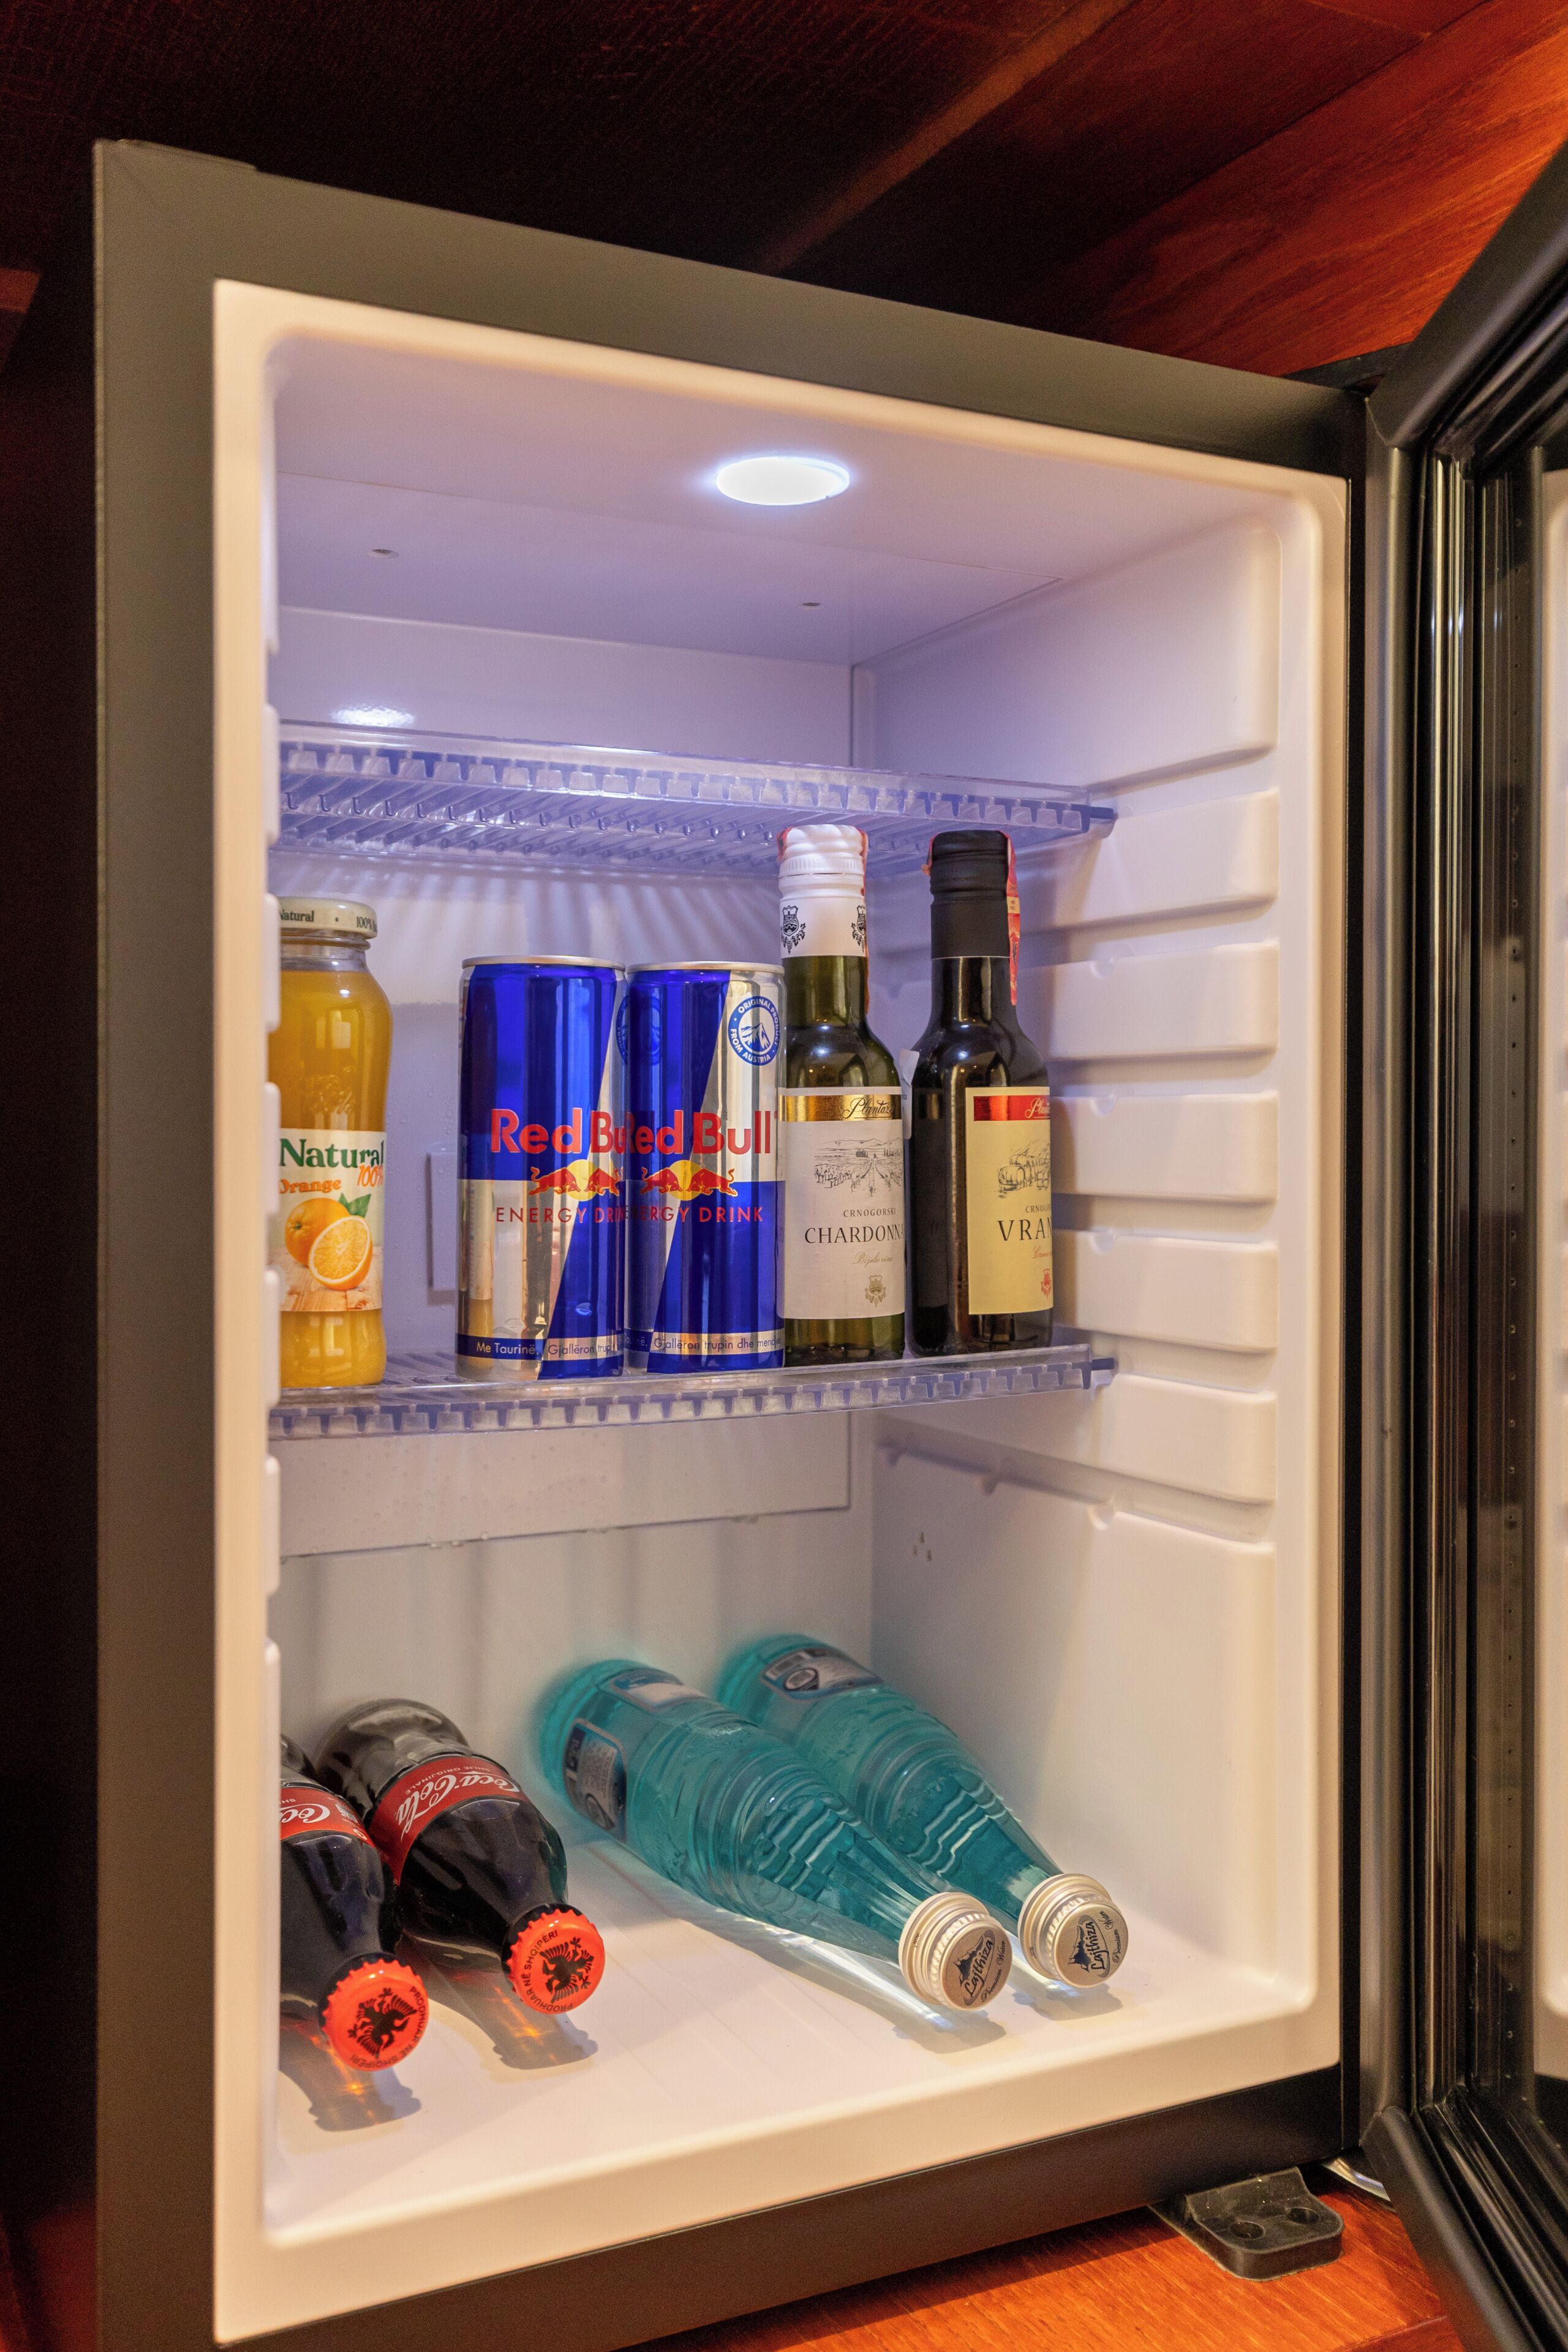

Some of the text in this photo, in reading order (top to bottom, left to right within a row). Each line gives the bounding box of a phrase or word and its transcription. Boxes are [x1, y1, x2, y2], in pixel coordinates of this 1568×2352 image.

[737, 998, 779, 1045] ORIGINAL PRODUCT
[730, 1028, 771, 1063] FROM AUSTRIA
[491, 1107, 582, 1154] Red
[693, 1110, 771, 1155] Bull
[279, 1137, 384, 1168] Natural
[279, 1178, 342, 1194] Orange
[496, 1207, 587, 1223] ENERGY
[699, 1206, 763, 1223] DRINK
[843, 1207, 896, 1218] CRNOGORSKI
[477, 1342, 491, 1353] Me
[494, 1342, 539, 1355] Taurinë.
[548, 1343, 595, 1358] Gjallëron
[654, 1336, 700, 1352] Gjallëron
[704, 1340, 733, 1352] trupin
[737, 1337, 755, 1349] dhe
[404, 1766, 461, 1796] ORIGJINALE
[396, 1771, 521, 1842] Coca-Cola
[1090, 1920, 1110, 1970] Lajthiza
[1099, 1910, 1124, 1964] Premium Water
[521, 1929, 574, 2013] PRODHUAR NË SHQIPËRI
[963, 1939, 994, 1997] Lajthiza
[981, 1940, 1006, 2003] Premium Water
